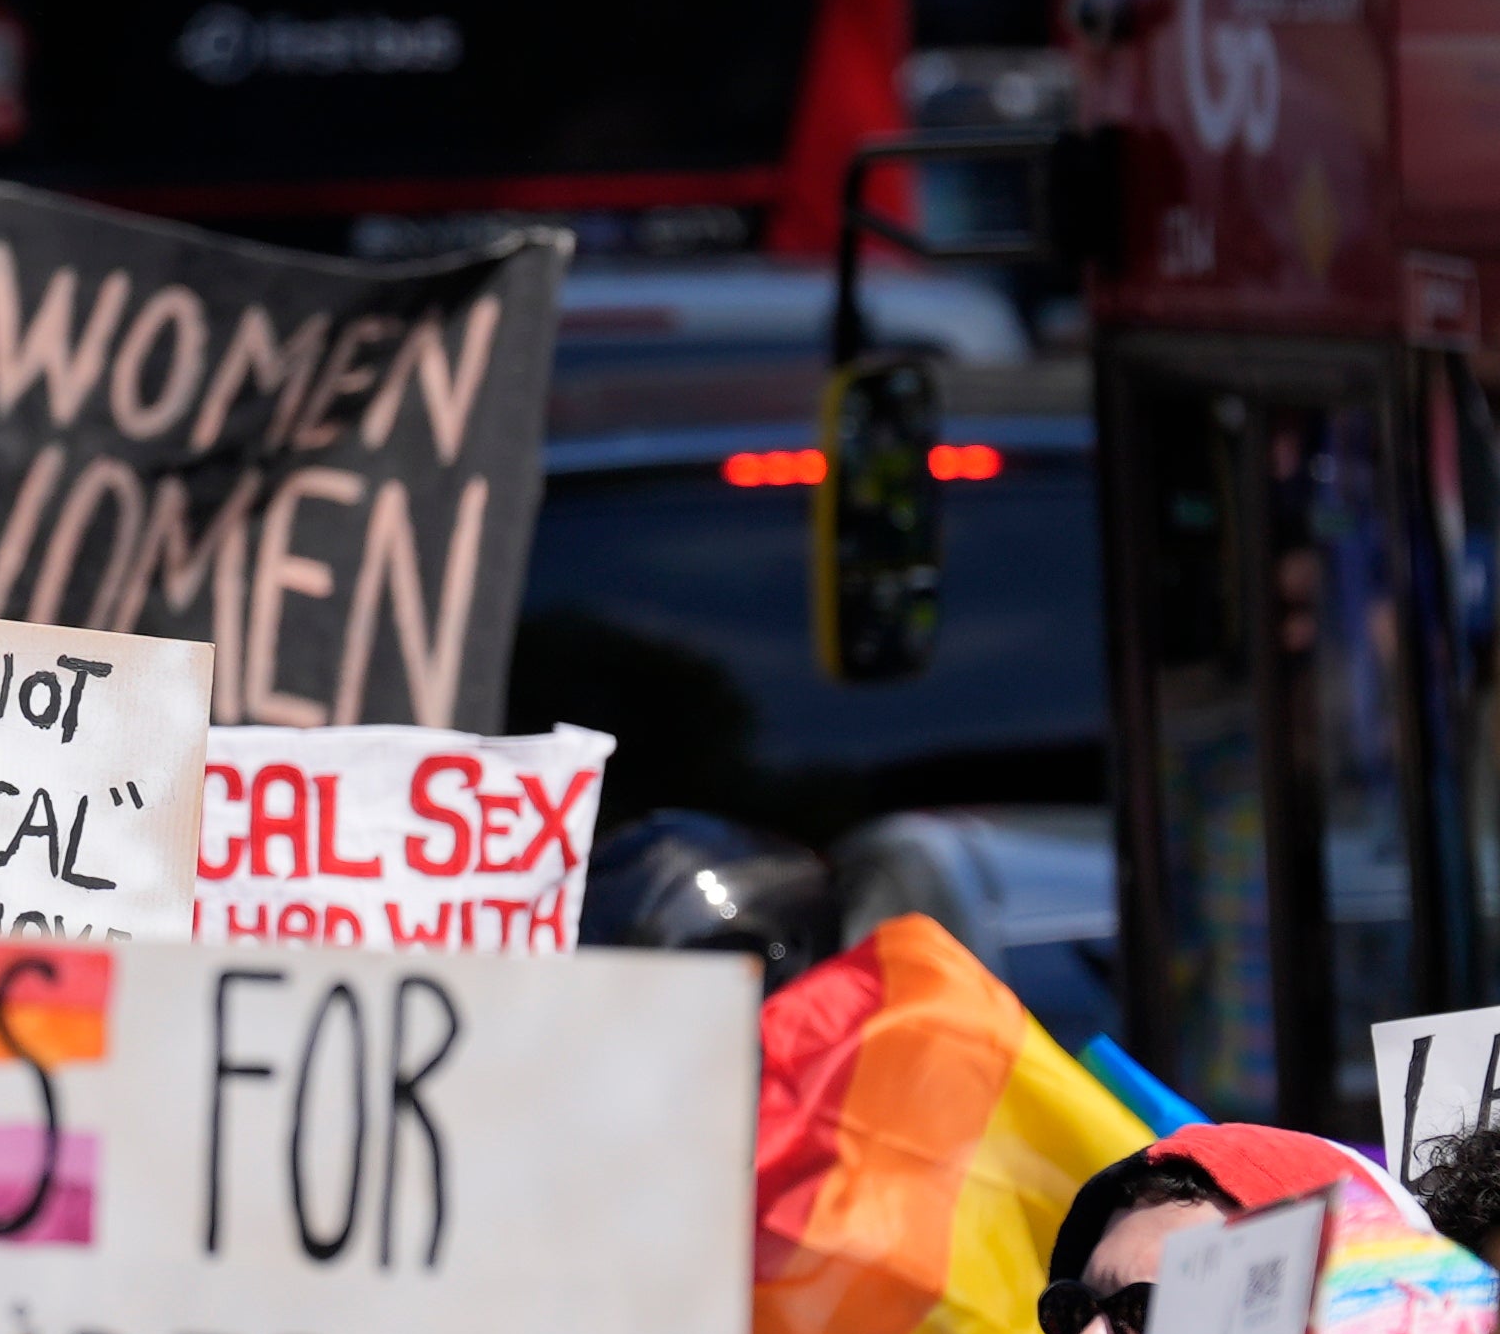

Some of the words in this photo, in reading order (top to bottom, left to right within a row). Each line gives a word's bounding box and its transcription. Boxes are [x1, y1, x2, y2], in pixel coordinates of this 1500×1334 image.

[405, 753, 598, 879] SEX
[384, 889, 565, 953] WITH
[202, 967, 462, 1271] FOR
